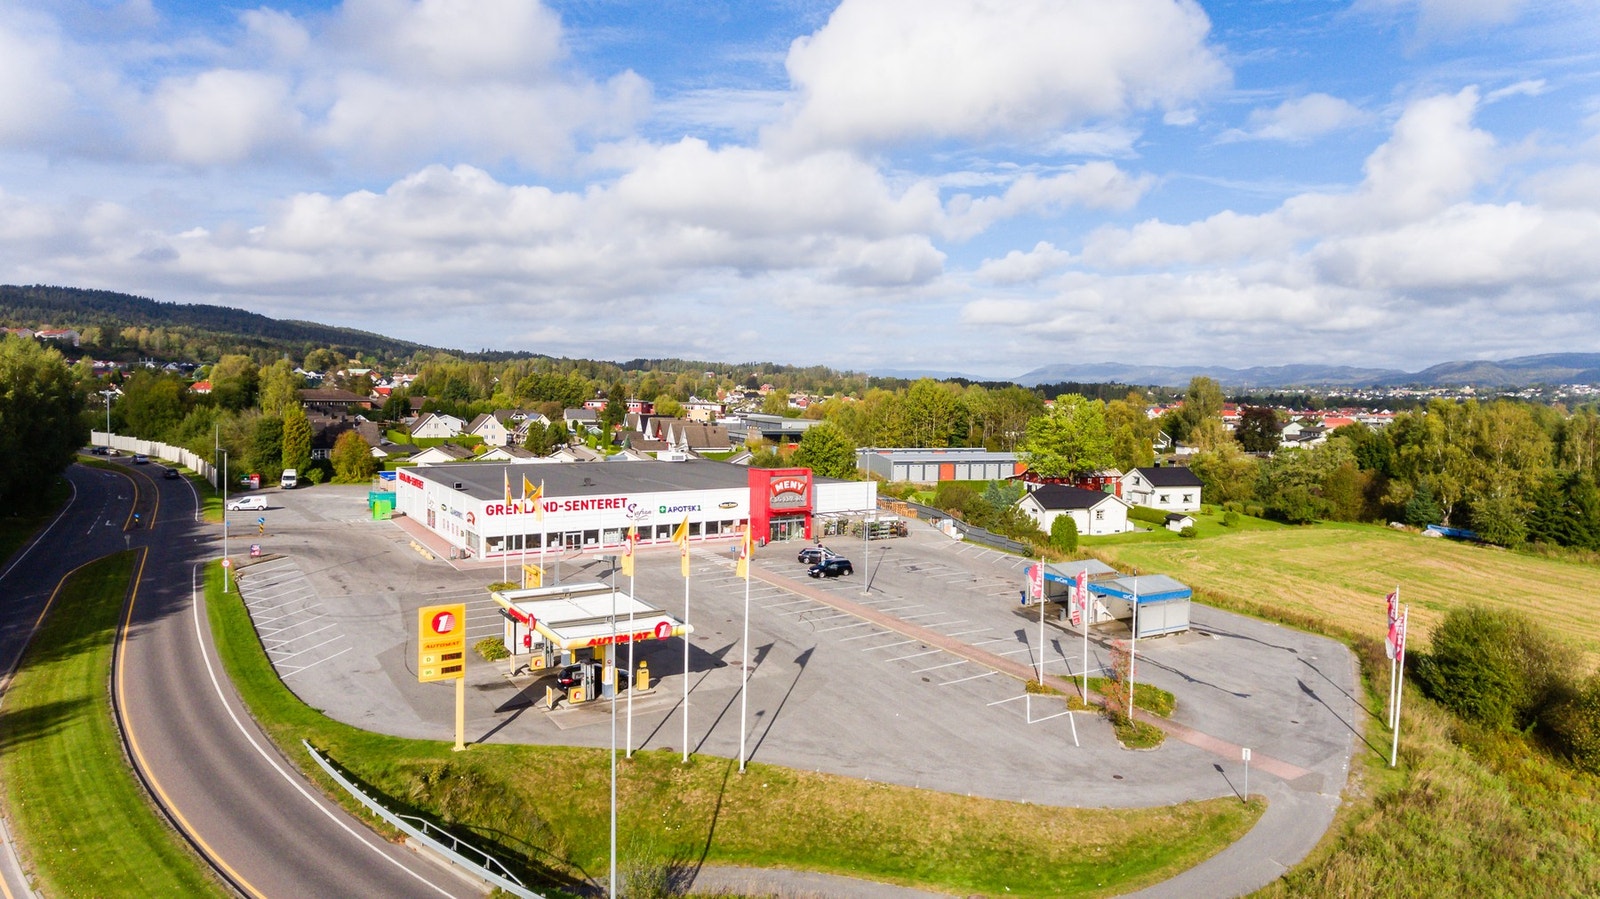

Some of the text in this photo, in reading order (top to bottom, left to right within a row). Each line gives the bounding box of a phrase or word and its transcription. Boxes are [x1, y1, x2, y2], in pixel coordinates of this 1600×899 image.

[774, 480, 804, 492] MENY
[485, 497, 628, 516] GRENLAND-SENTERET
[667, 505, 697, 513] APOTEK
[425, 640, 461, 649] AUTOMAT
[586, 631, 651, 646] AUTOMAT
